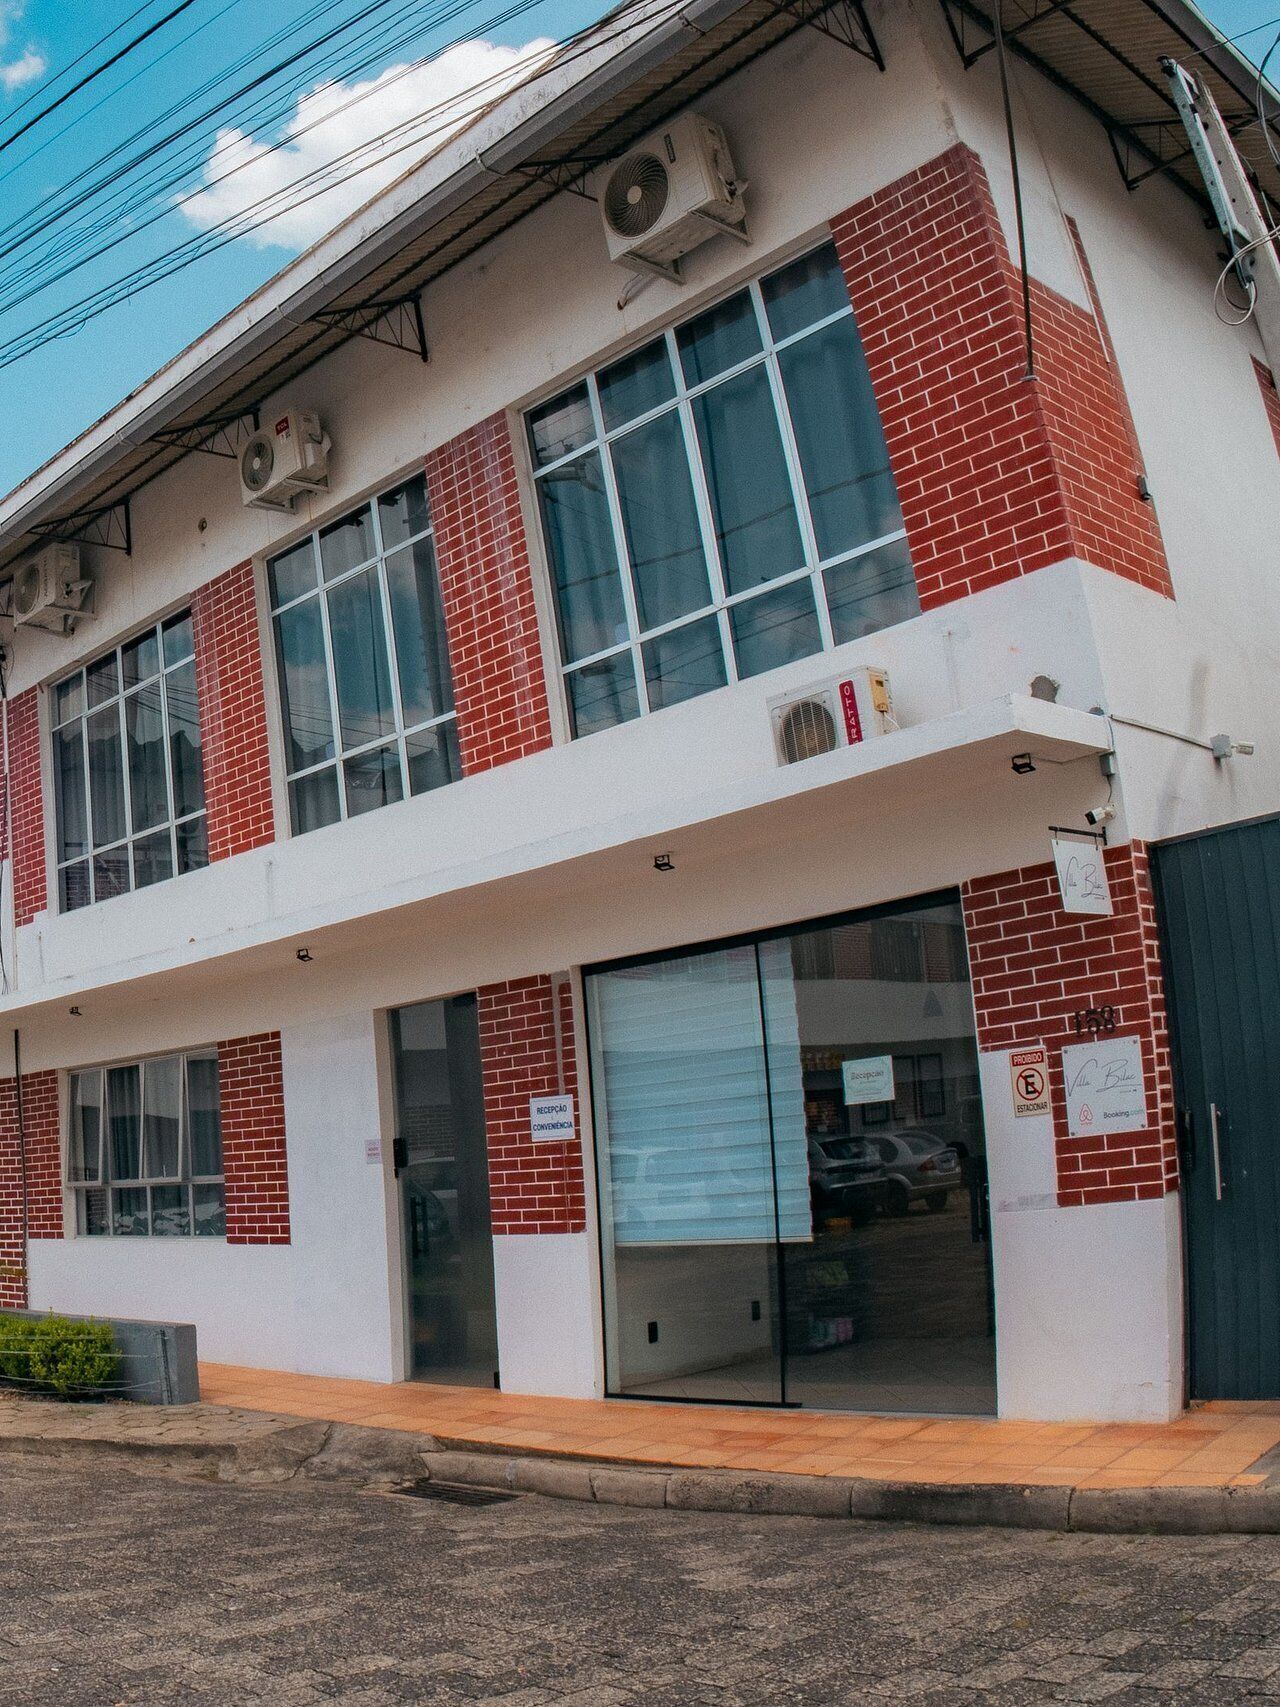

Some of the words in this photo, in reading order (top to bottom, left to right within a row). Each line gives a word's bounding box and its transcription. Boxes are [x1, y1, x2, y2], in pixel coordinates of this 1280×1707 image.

[844, 685, 859, 744] RATTO
[1074, 1005, 1115, 1037] 158
[1013, 1052, 1042, 1065] PROIBIDO
[536, 1103, 567, 1115] RECEPÇÃO
[1016, 1101, 1048, 1113] ESTACIONAR
[532, 1120, 573, 1132] CONVENIÊNCIA
